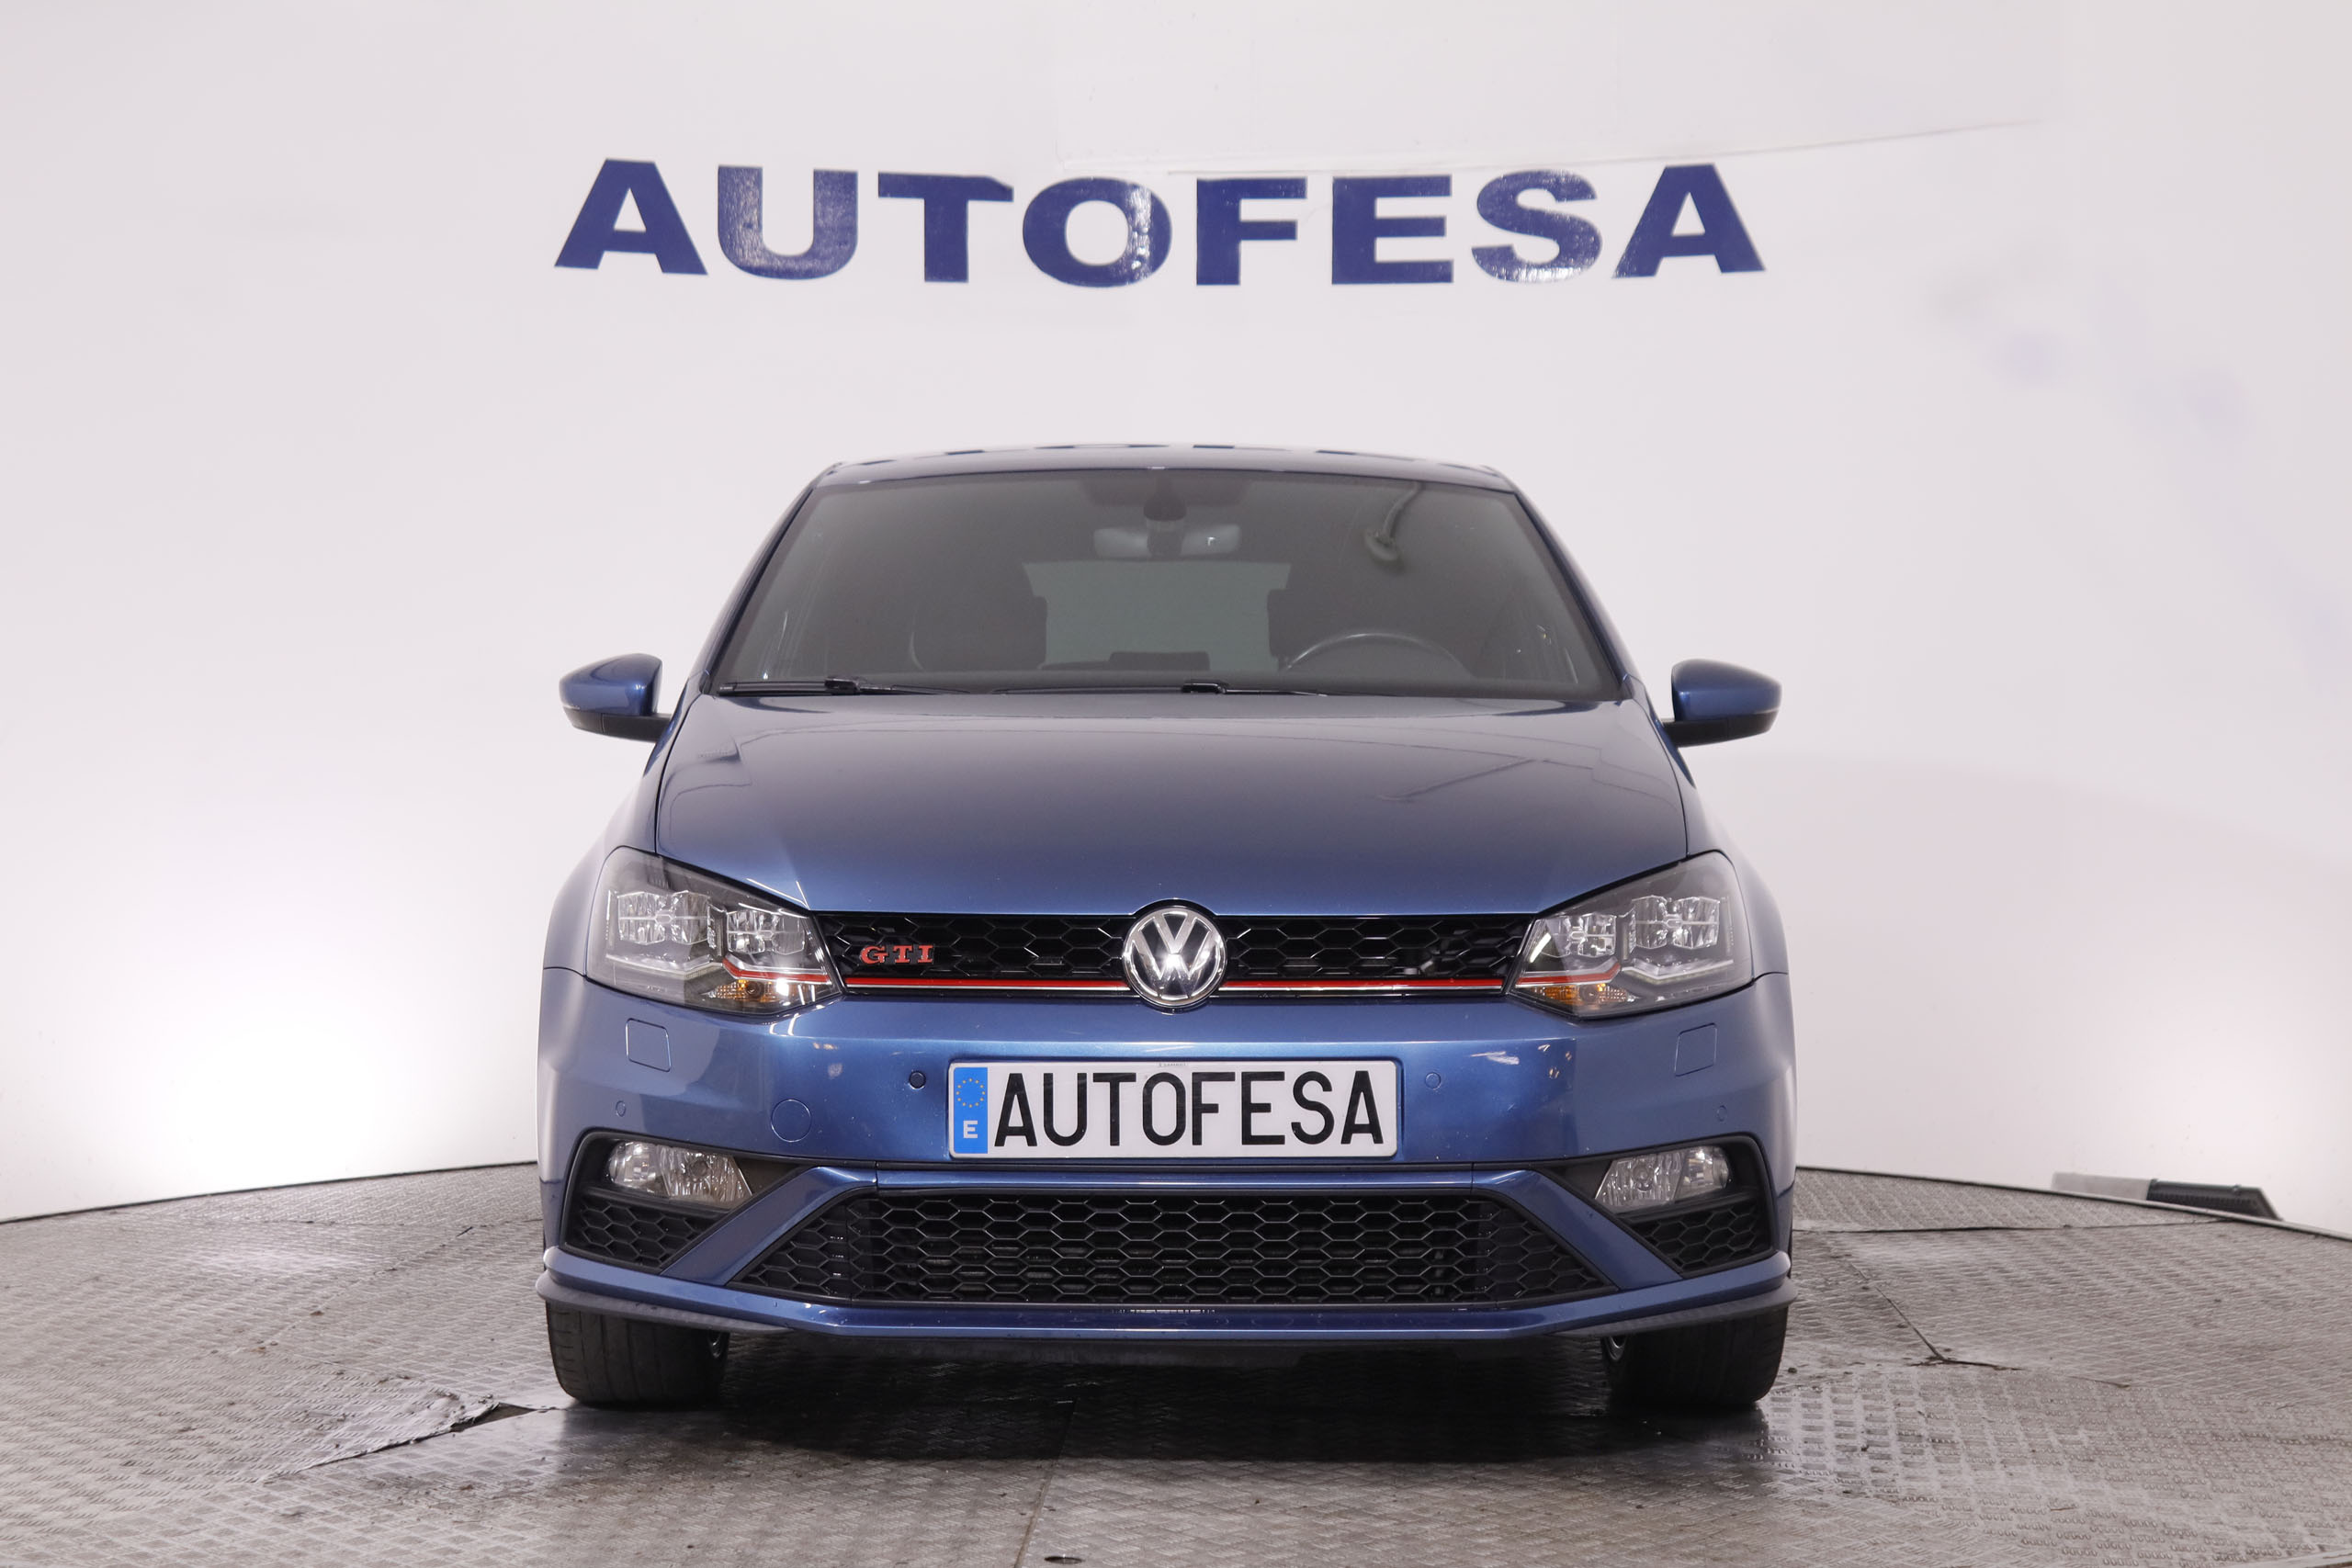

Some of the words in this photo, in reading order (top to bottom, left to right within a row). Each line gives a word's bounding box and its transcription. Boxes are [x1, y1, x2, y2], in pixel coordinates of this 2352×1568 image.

[554, 158, 1765, 288] AUTOFESA
[860, 944, 934, 964] GTI
[963, 1120, 978, 1139] E
[994, 1070, 1384, 1147] AUTOFESA
